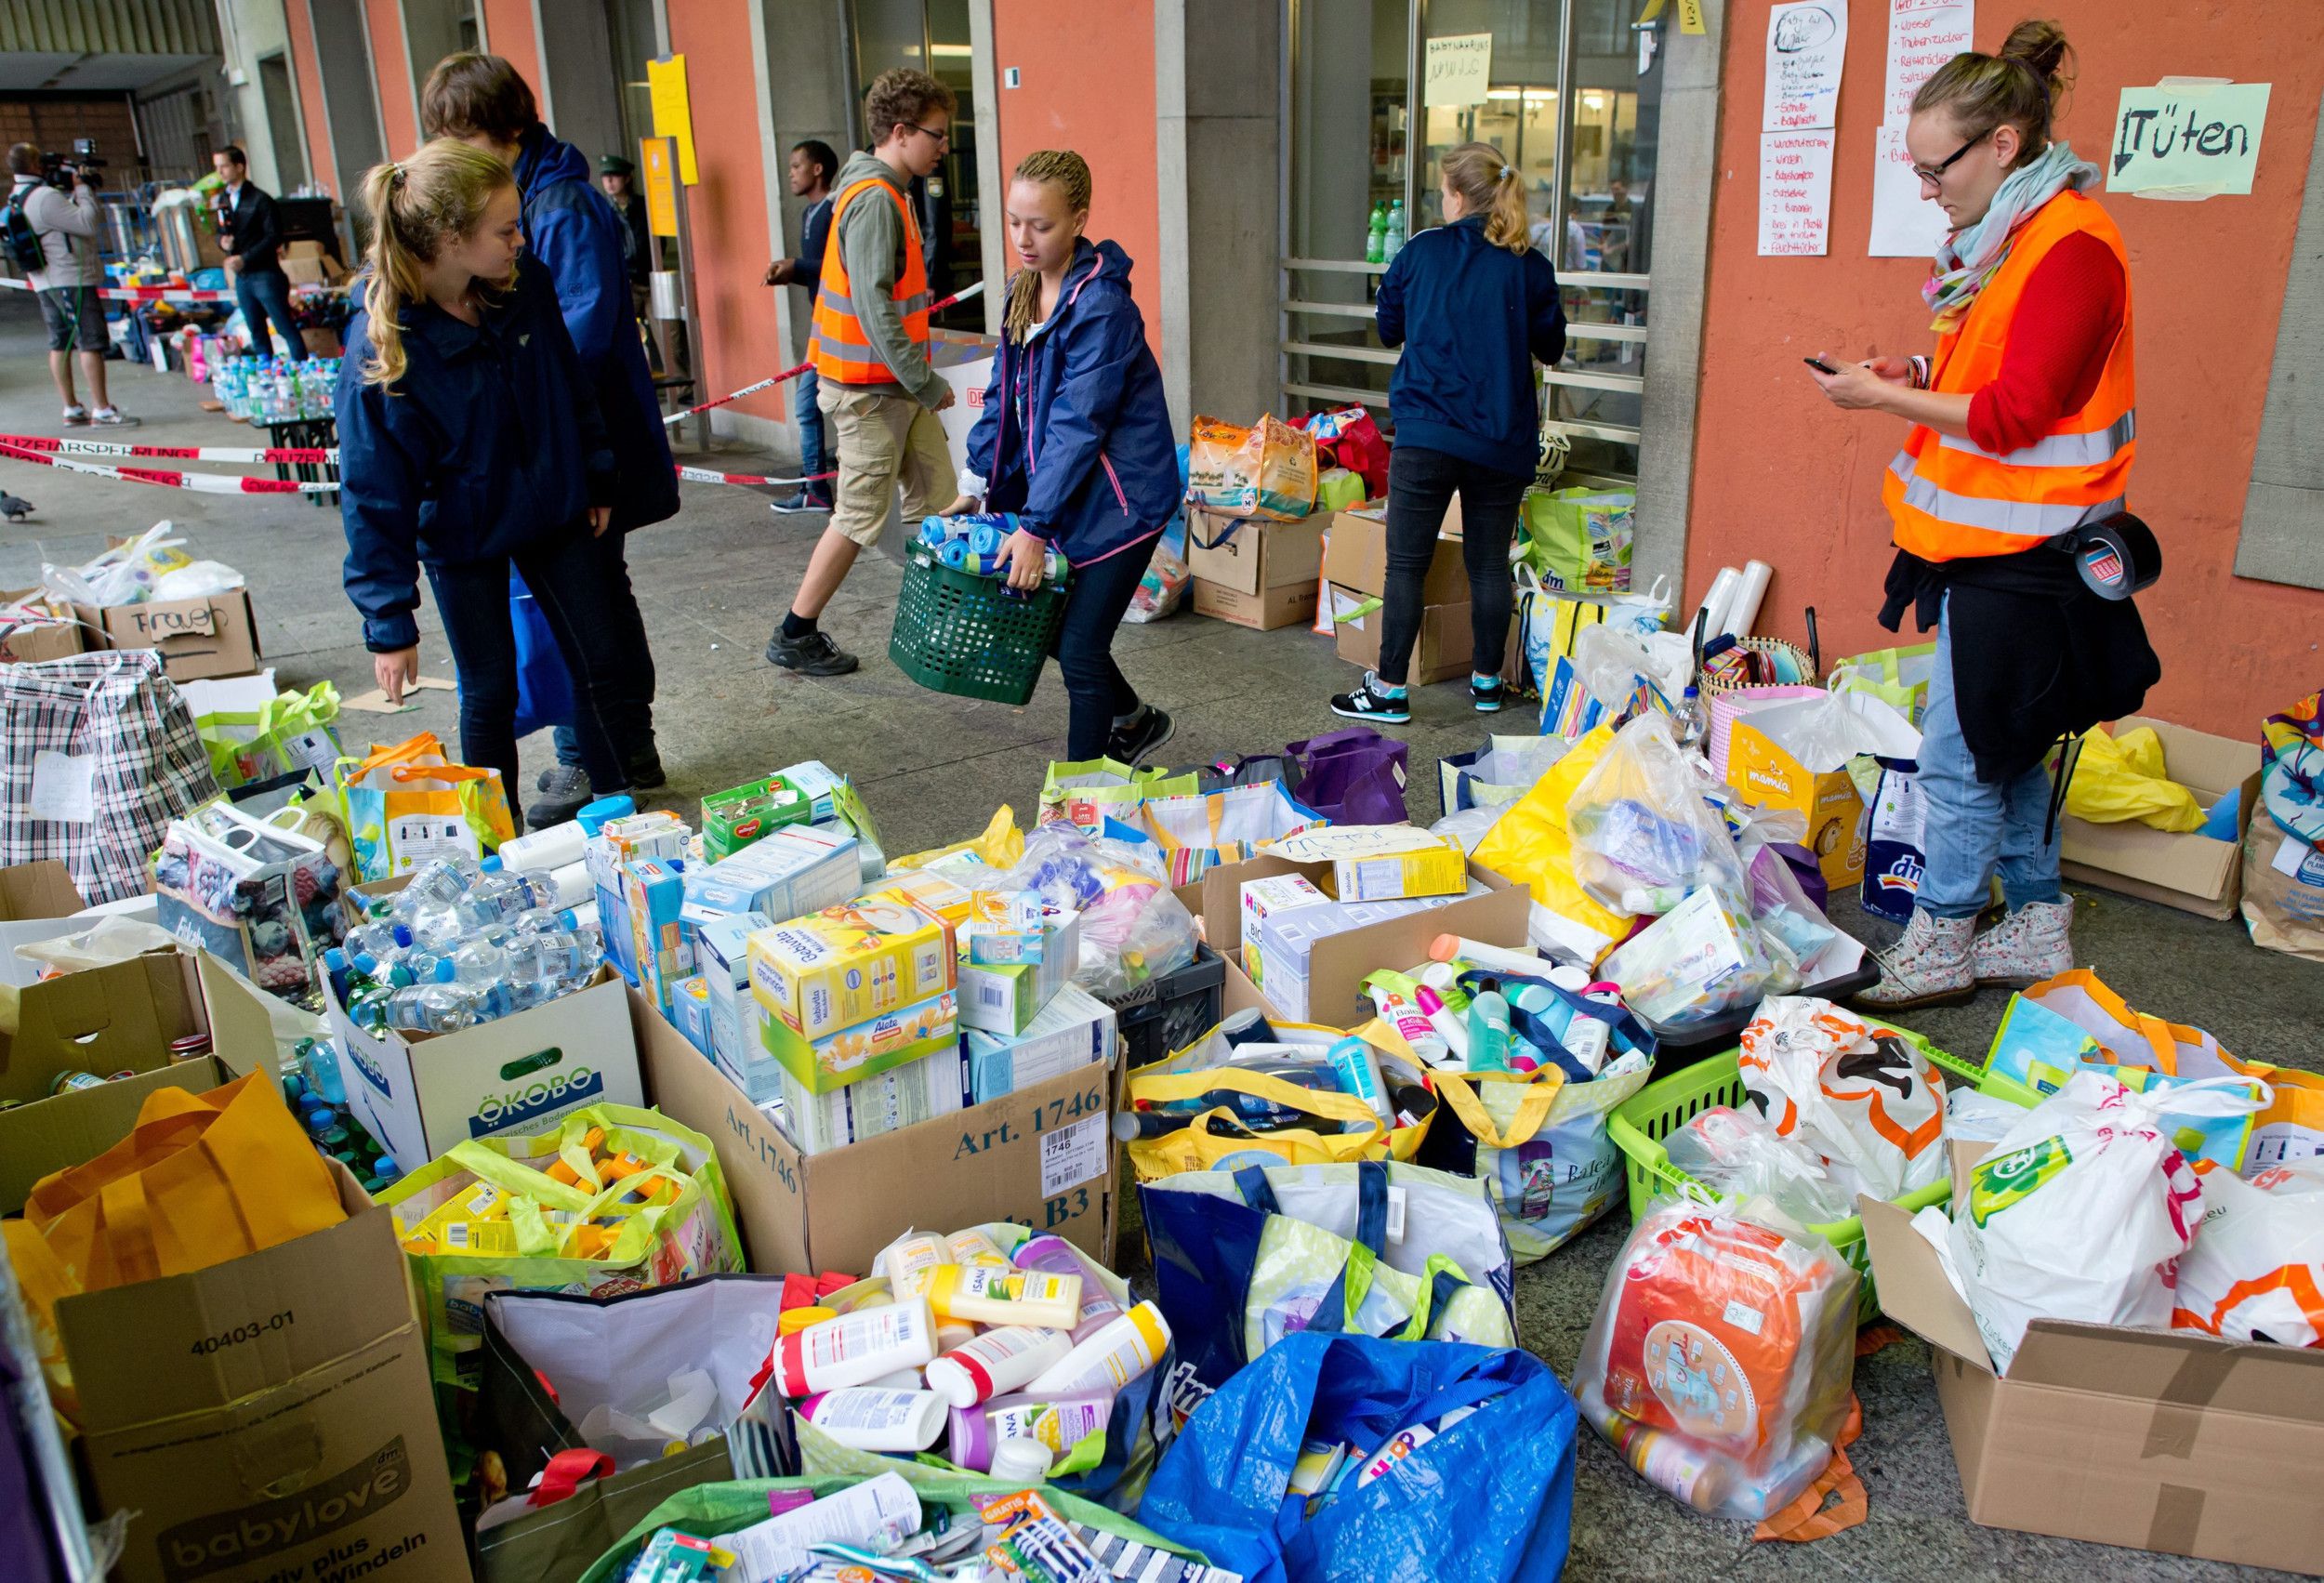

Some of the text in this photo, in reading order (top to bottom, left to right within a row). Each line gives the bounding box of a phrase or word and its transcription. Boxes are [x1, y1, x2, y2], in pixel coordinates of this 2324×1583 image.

[2129, 103, 2249, 159] Tüten
[1542, 570, 1565, 589] dm
[1749, 770, 1791, 794] mamia
[1820, 791, 1853, 804] mamia
[1294, 878, 1317, 895] HiPP
[1246, 892, 1268, 920] HiPP
[776, 930, 818, 964] Bebivita
[812, 990, 822, 1025] Bebivita
[874, 1019, 898, 1034] Alete
[478, 1066, 592, 1128] ÖKOBO
[953, 1120, 1020, 1161] Art.
[1032, 1084, 1101, 1134] 1746
[726, 1104, 797, 1194] Art. 1746
[1045, 1139, 1071, 1157] 1746
[1045, 1188, 1089, 1229] B3
[191, 1310, 295, 1356] 40403-01
[376, 1446, 399, 1465] dm
[171, 1467, 401, 1569] babylove
[984, 1497, 1025, 1521] GRATIS
[312, 1537, 370, 1575] plus
